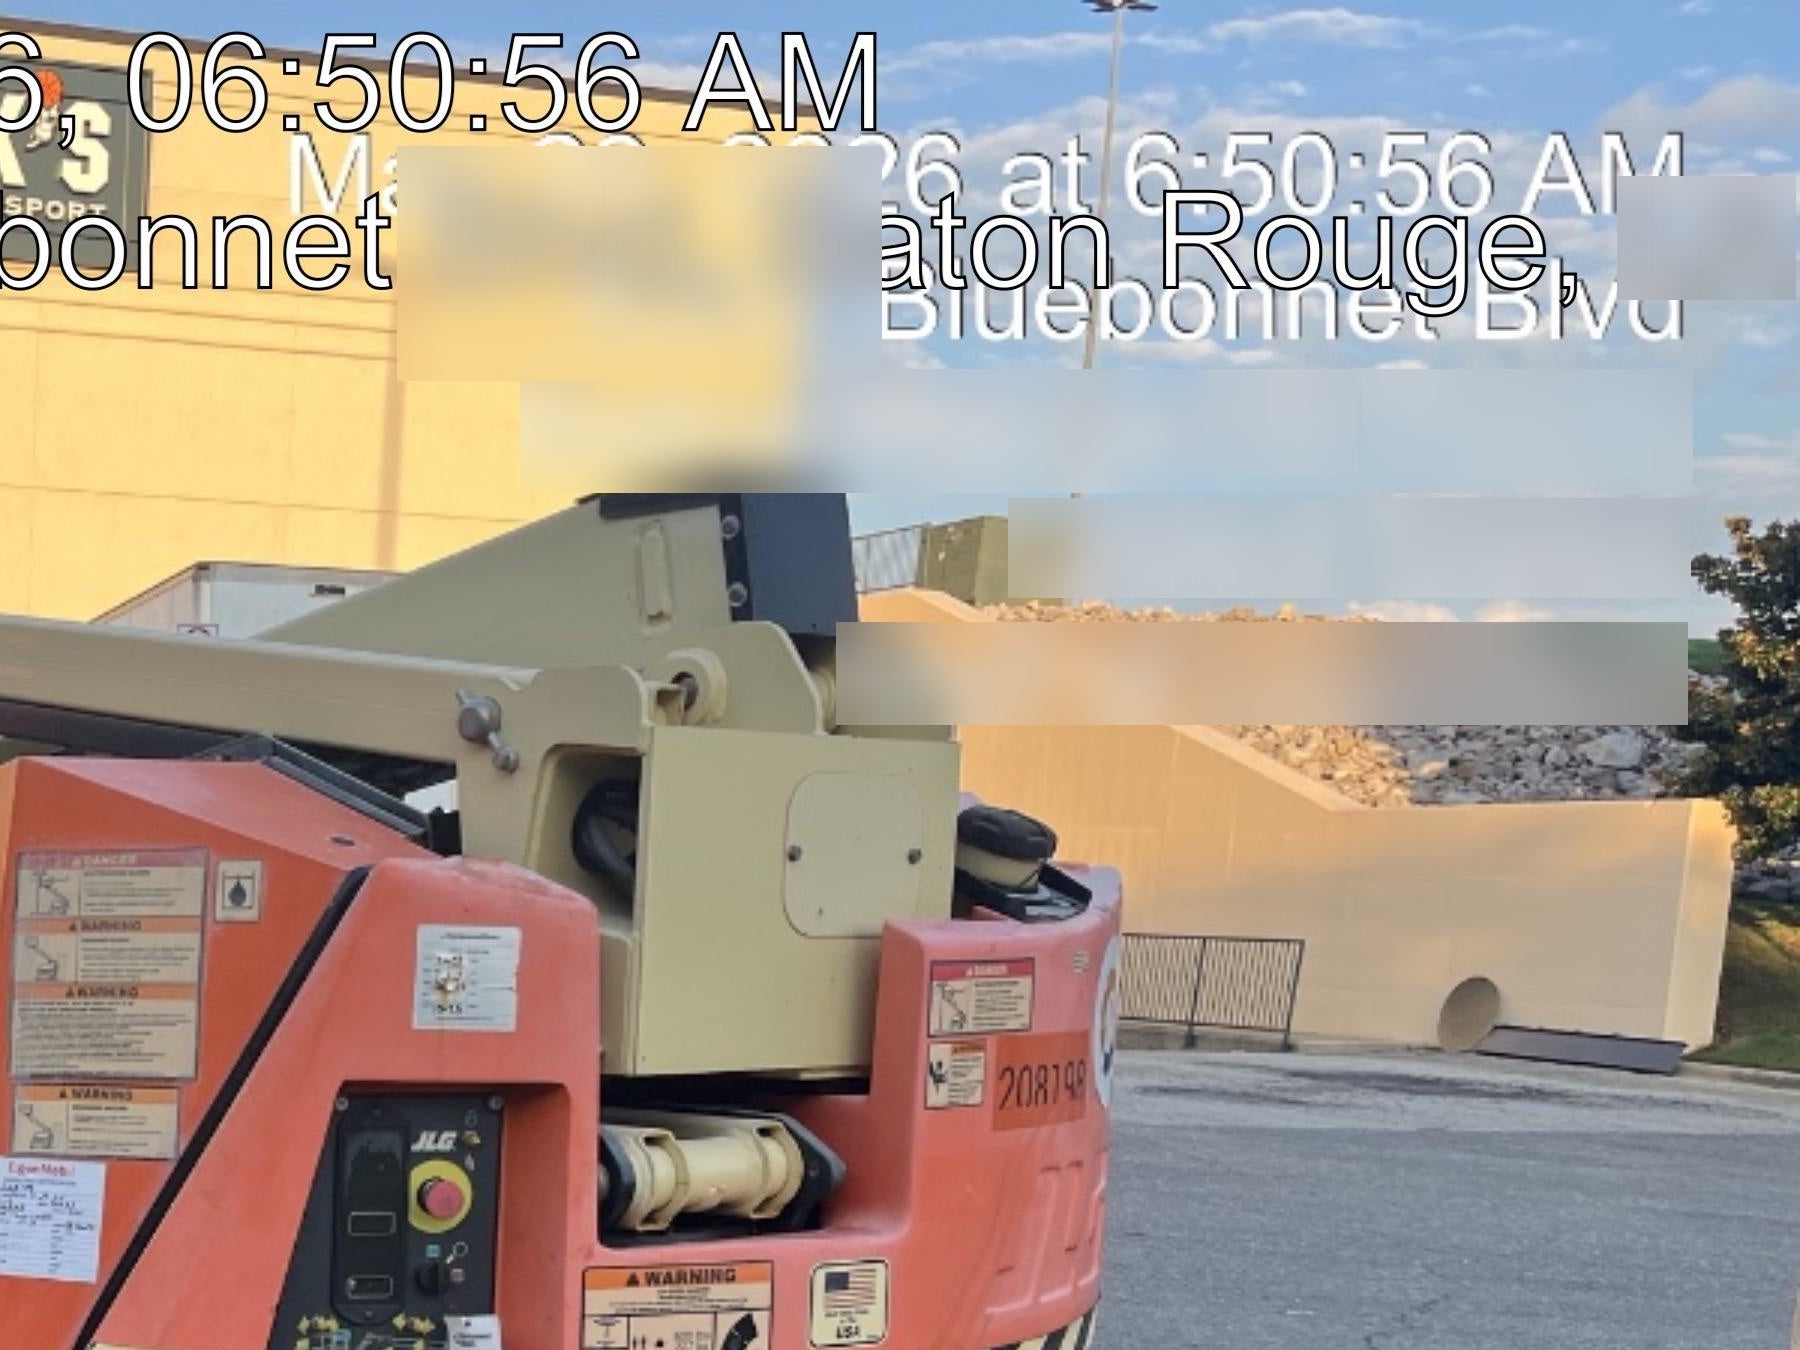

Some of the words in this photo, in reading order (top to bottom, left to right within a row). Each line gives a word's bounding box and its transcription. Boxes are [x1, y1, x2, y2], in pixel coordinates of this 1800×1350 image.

[4, 194, 108, 222] SPORT
[410, 1129, 458, 1153] JLG
[644, 1267, 737, 1287] WARNING
